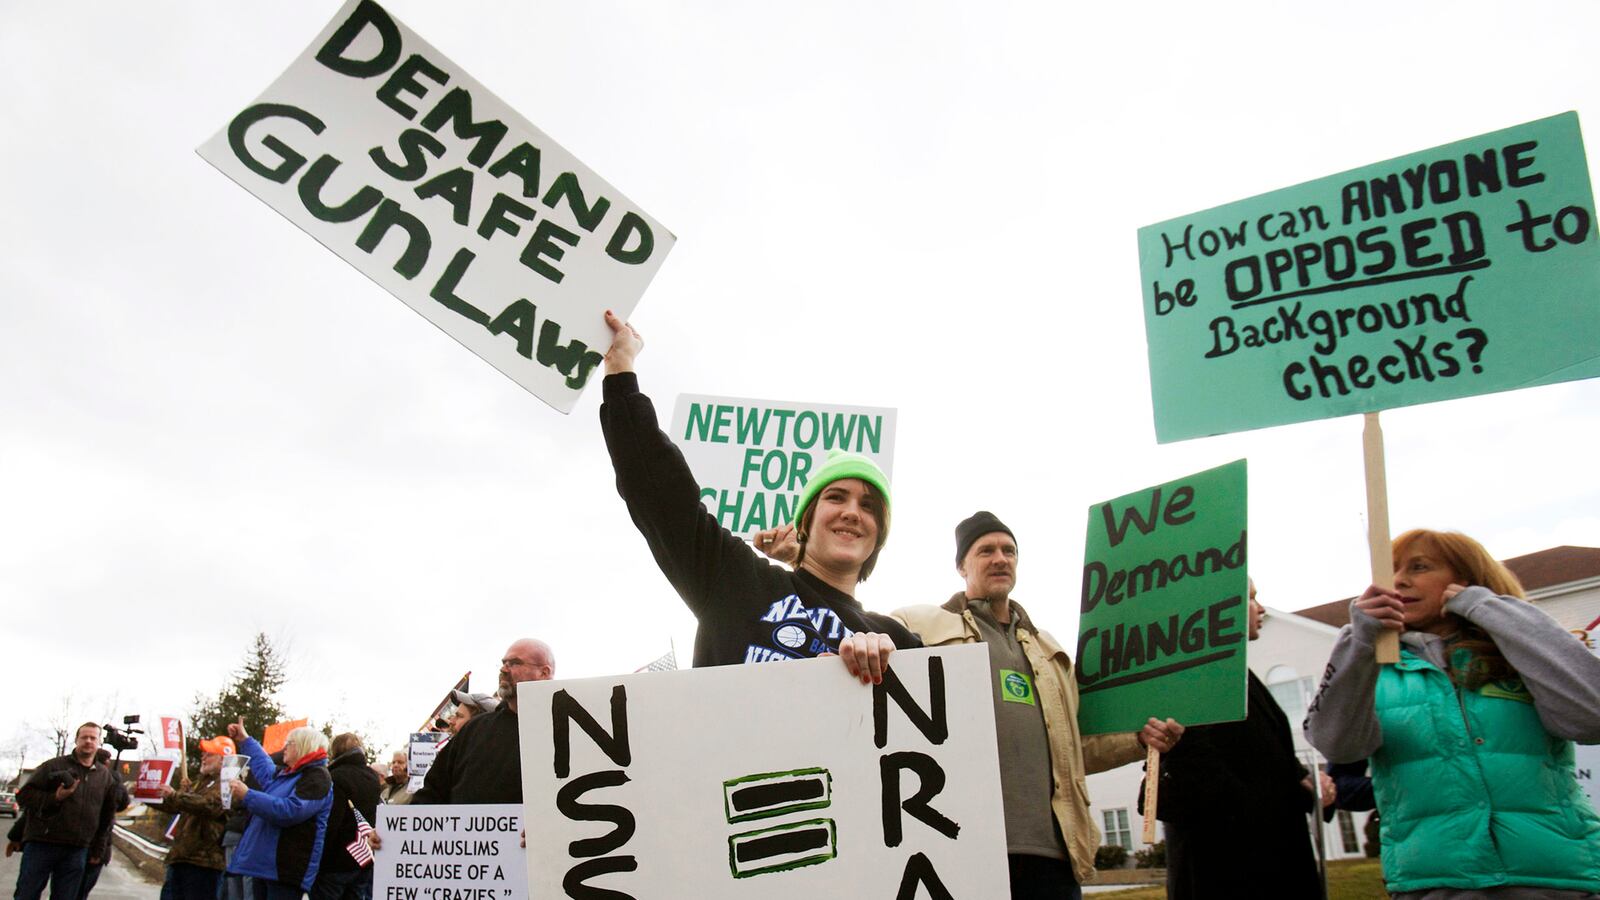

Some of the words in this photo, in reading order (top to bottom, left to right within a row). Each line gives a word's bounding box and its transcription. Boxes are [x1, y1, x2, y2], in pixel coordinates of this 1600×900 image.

[315, 0, 655, 265] DEMAND
[368, 128, 581, 284] SAFE
[1161, 223, 1248, 268] How
[1257, 204, 1330, 242] can
[1342, 140, 1546, 226] ANYONE
[1153, 277, 1199, 316] be
[1224, 210, 1487, 302] OPPOSED
[1505, 198, 1591, 253] to
[684, 402, 883, 454] NEWTOWN
[740, 448, 813, 492] FOR
[1102, 485, 1196, 548] We
[1080, 529, 1247, 614] Demand
[1075, 595, 1246, 686] CHANGE
[386, 816, 407, 832] WE
[413, 816, 461, 832] DON’T
[465, 816, 518, 832] JUDGE
[400, 840, 427, 855] ALL
[432, 840, 499, 856] MUSLIMS
[387, 887, 418, 900] FEW
[424, 888, 512, 900] “CRAZIES”
[396, 863, 462, 879] BECAUSE
[467, 865, 489, 880] OF
[494, 865, 505, 880] A
